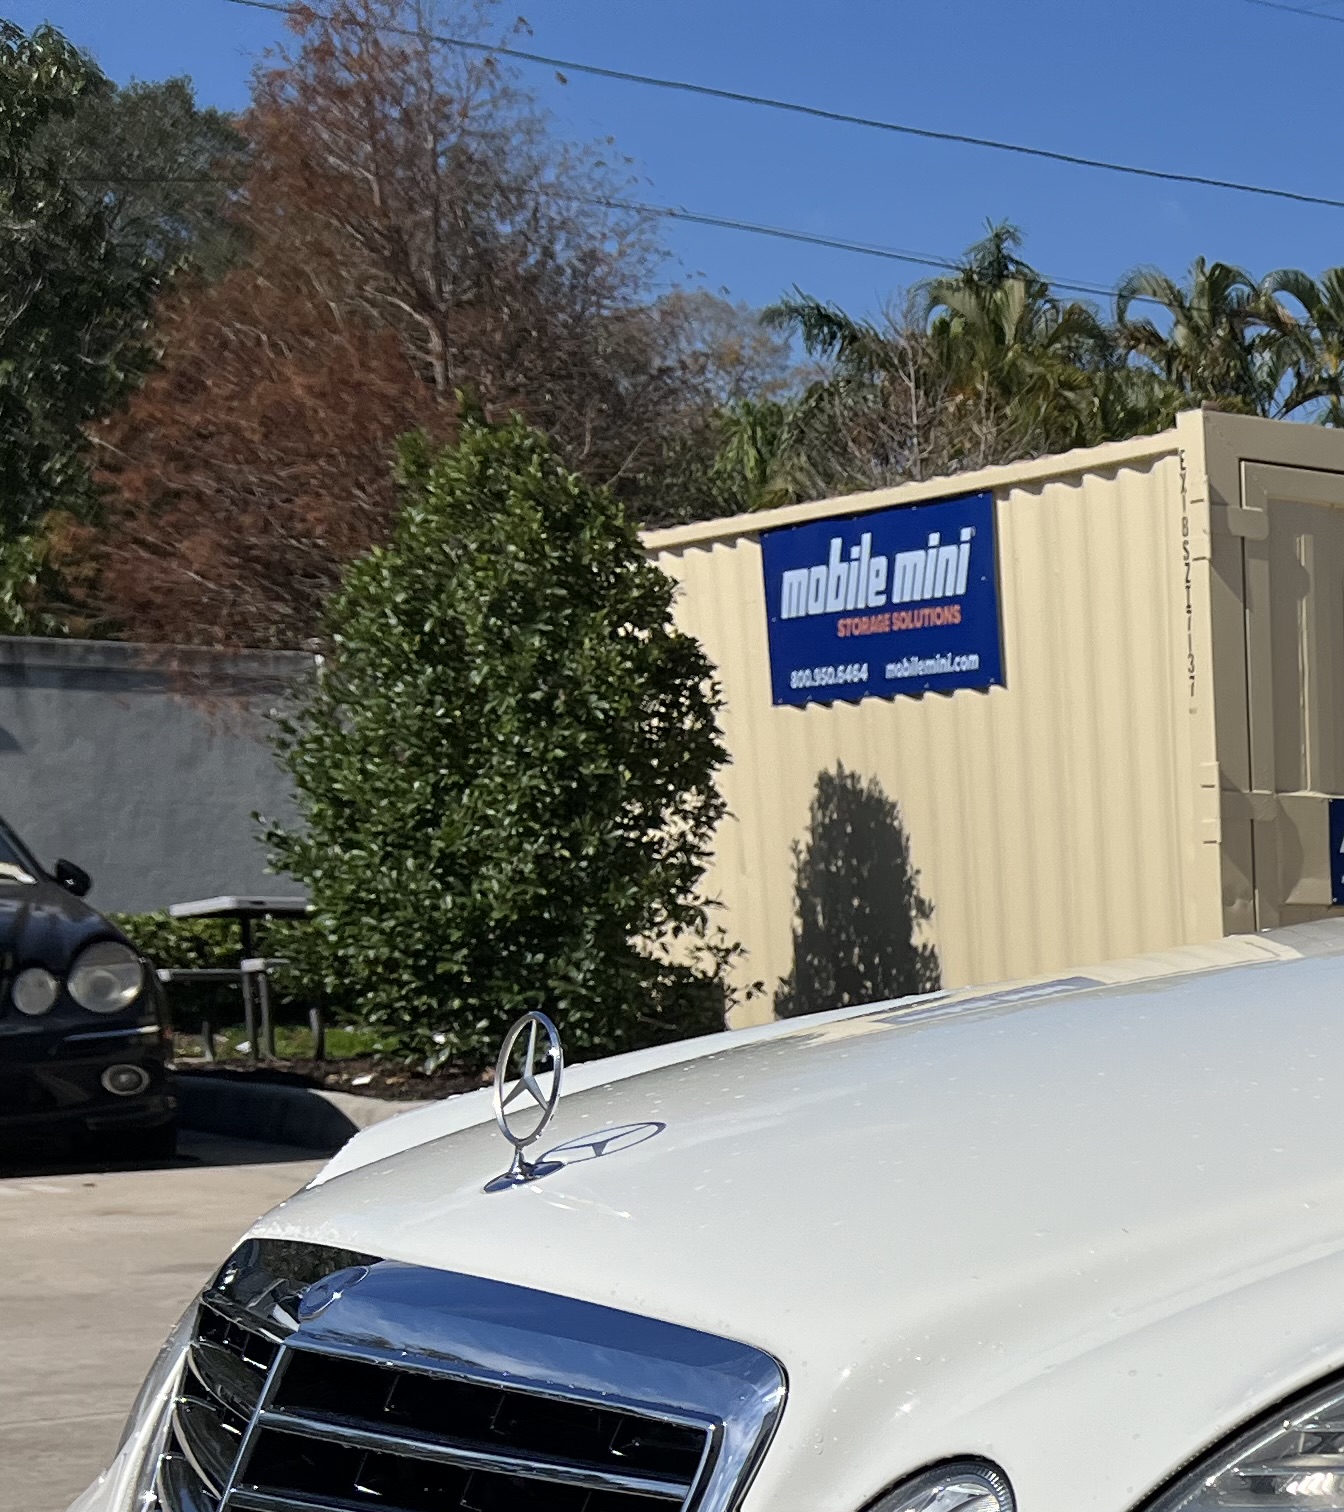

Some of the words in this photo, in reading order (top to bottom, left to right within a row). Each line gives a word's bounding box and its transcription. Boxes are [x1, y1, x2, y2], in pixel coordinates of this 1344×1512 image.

[780, 532, 888, 619] mobile
[892, 527, 974, 604] mini
[836, 612, 891, 638] STORAGE
[891, 603, 962, 632] SOLUTIONS
[885, 653, 979, 679] mobilemini.com
